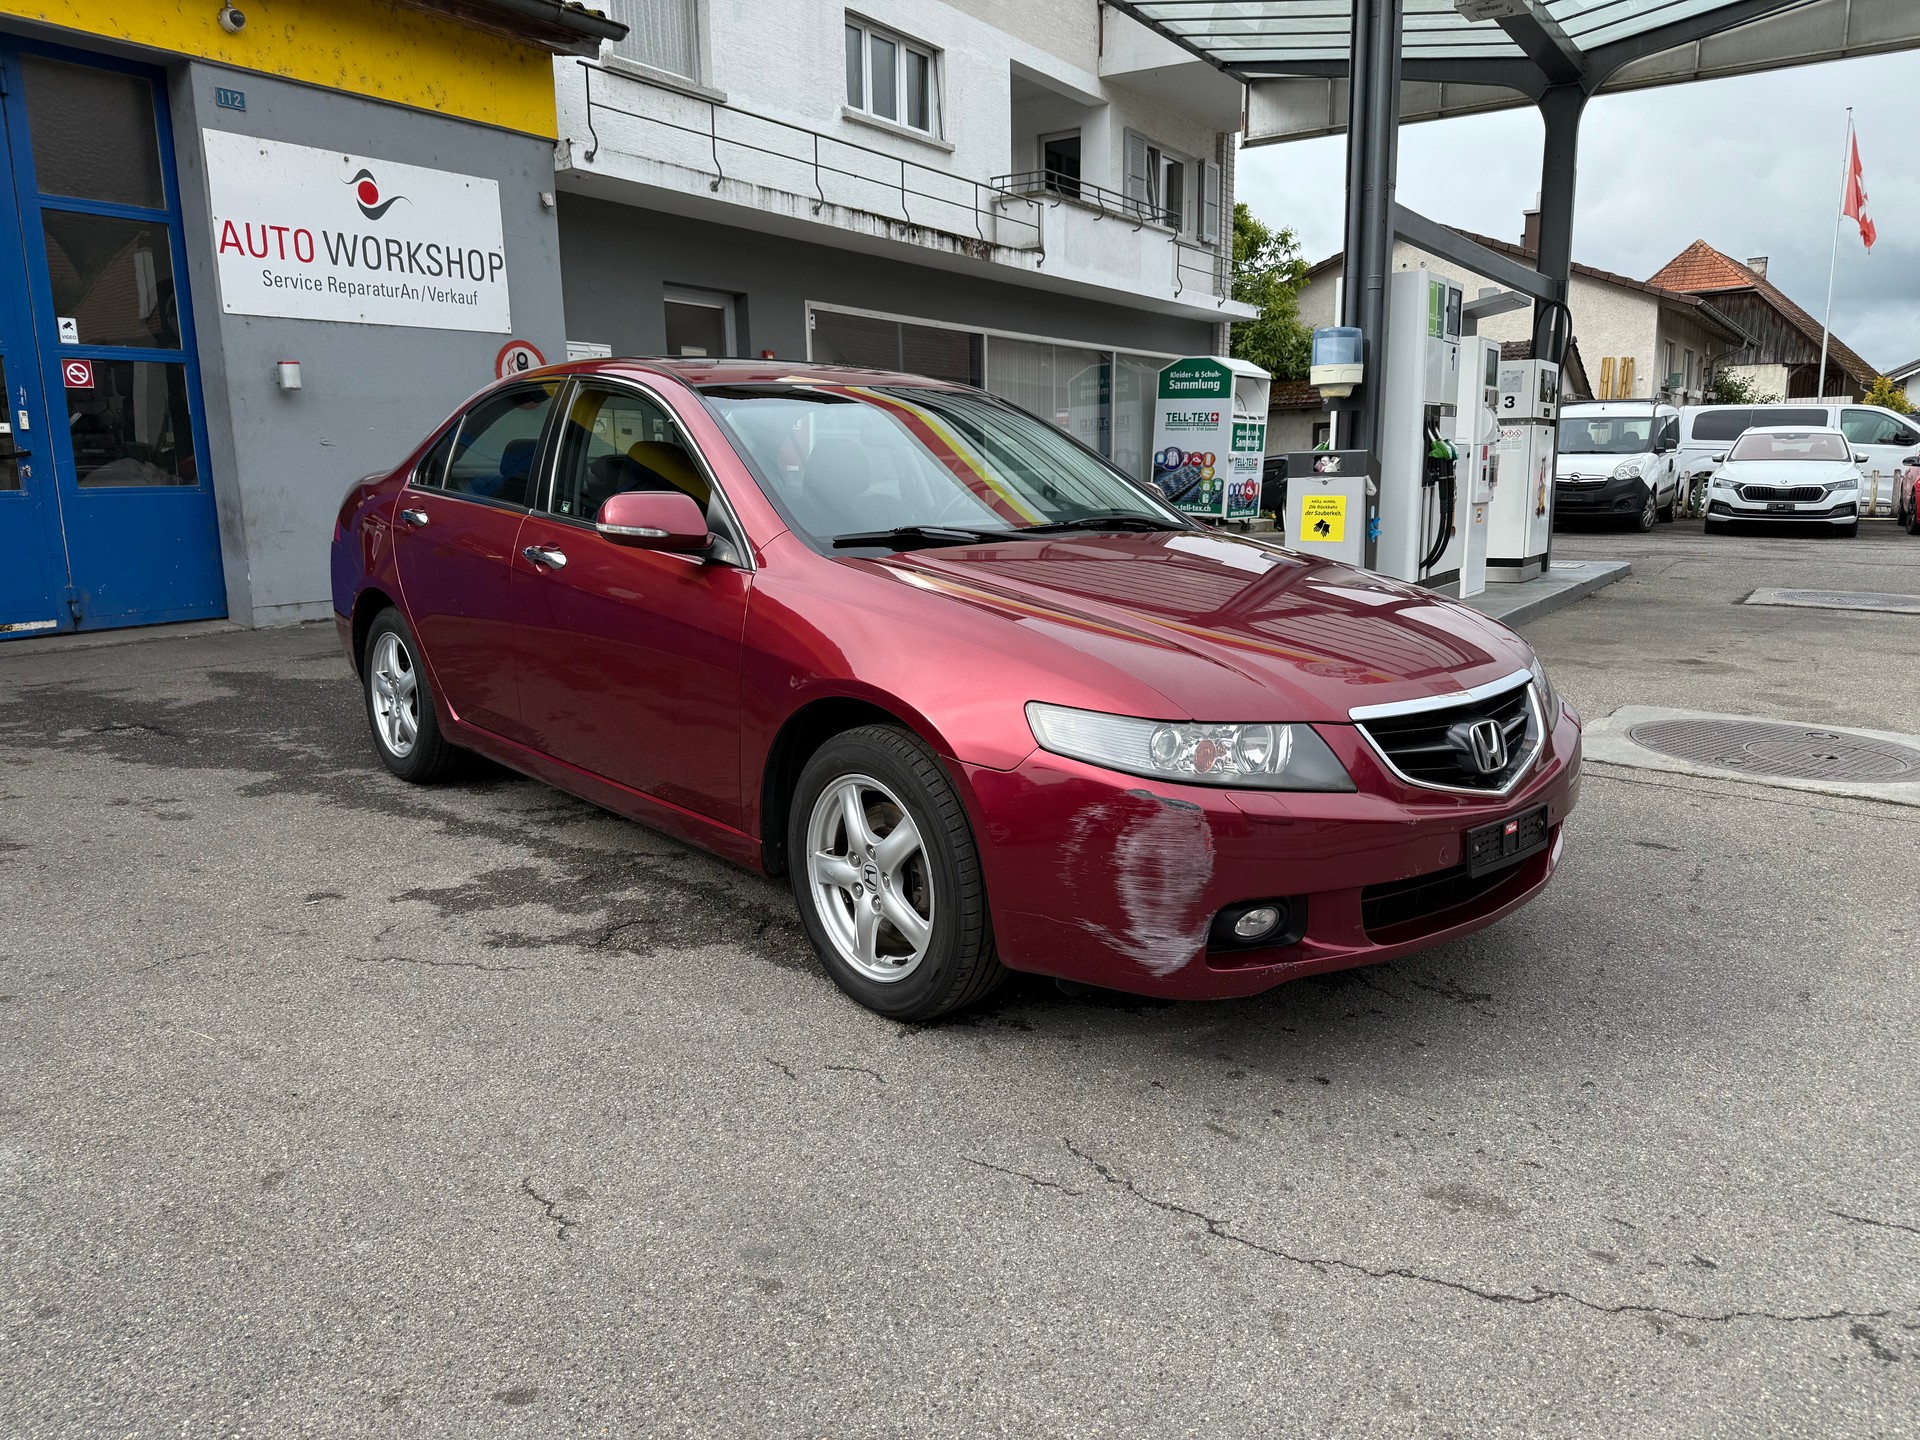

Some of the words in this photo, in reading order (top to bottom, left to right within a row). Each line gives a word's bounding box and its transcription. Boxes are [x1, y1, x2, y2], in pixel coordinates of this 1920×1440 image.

[220, 90, 241, 107] 112
[219, 219, 315, 264] AUTO
[322, 229, 504, 283] WORKSHOP
[262, 269, 322, 291] Service
[1200, 370, 1221, 378] Schuh-
[1169, 379, 1221, 391] Sammlung
[1504, 395, 1515, 408] 3
[1166, 412, 1211, 422] TELL-TEX
